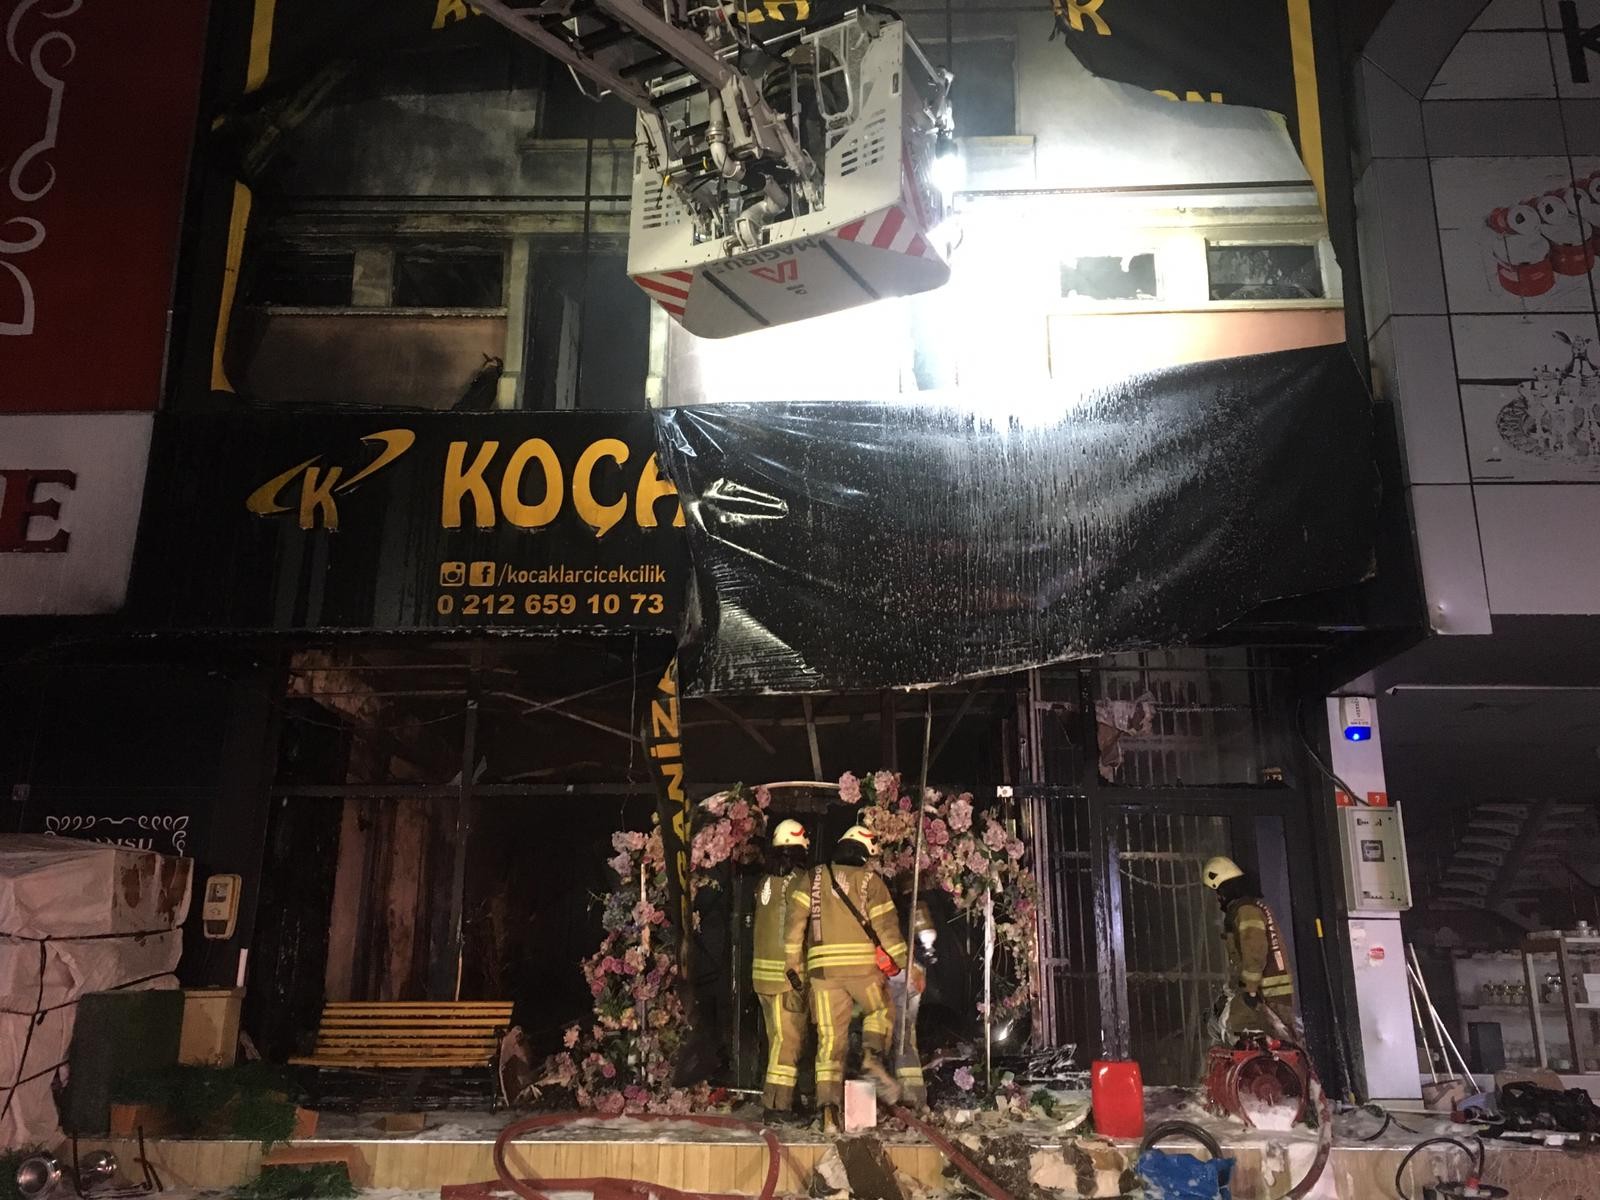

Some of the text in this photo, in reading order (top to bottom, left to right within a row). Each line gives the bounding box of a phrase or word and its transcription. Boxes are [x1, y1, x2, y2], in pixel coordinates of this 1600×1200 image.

[437, 593, 665, 615] 0 212 659 10 73
